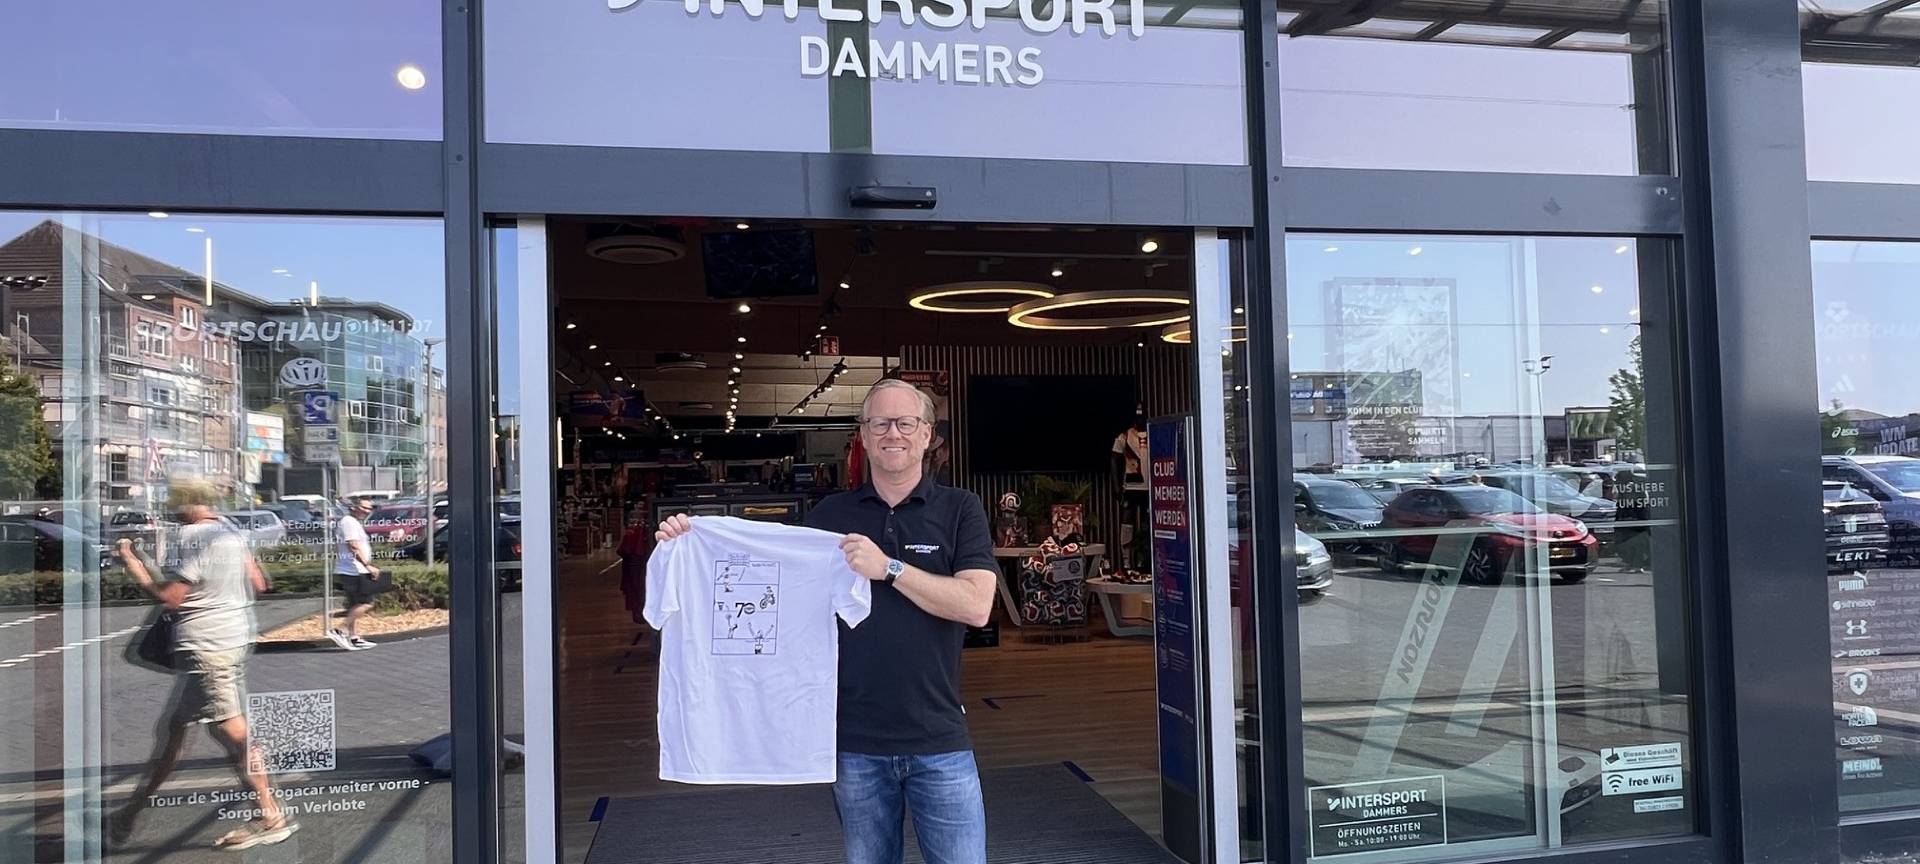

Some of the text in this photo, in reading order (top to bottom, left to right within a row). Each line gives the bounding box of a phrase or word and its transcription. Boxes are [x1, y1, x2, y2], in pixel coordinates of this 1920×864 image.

[800, 36, 1044, 85] DAMMERS
[1347, 406, 1372, 415] KOMM
[1374, 406, 1383, 415] IN
[1385, 406, 1401, 415] DEN
[1880, 425, 1906, 443] WM
[1874, 437, 1919, 455] UPDATE
[1153, 461, 1175, 477] CLUB
[1154, 485, 1186, 501] MEMBER
[1611, 482, 1665, 494] AUS LIEBE
[1636, 497, 1670, 508] SPORT
[288, 519, 325, 530] Etappe
[394, 515, 428, 527] Suisse
[1154, 509, 1186, 526] WERDEN
[1835, 551, 1870, 562] LEKI
[1397, 568, 1448, 684] HORIZON
[1848, 648, 1881, 657] BROOKS
[1628, 774, 1674, 787] free WiFi
[148, 793, 185, 808] Tour
[187, 791, 206, 805] de
[210, 788, 262, 804] Suisse:
[267, 783, 325, 802] Pogacar
[329, 780, 374, 794] weiter
[378, 778, 420, 792] vorne
[1341, 789, 1427, 809] INTERSPORT
[217, 798, 366, 822] Sorgen um Verlobte
[1363, 805, 1408, 818] DAMMERS
[1337, 822, 1420, 838] ÖFFNUNGSZEITEN
